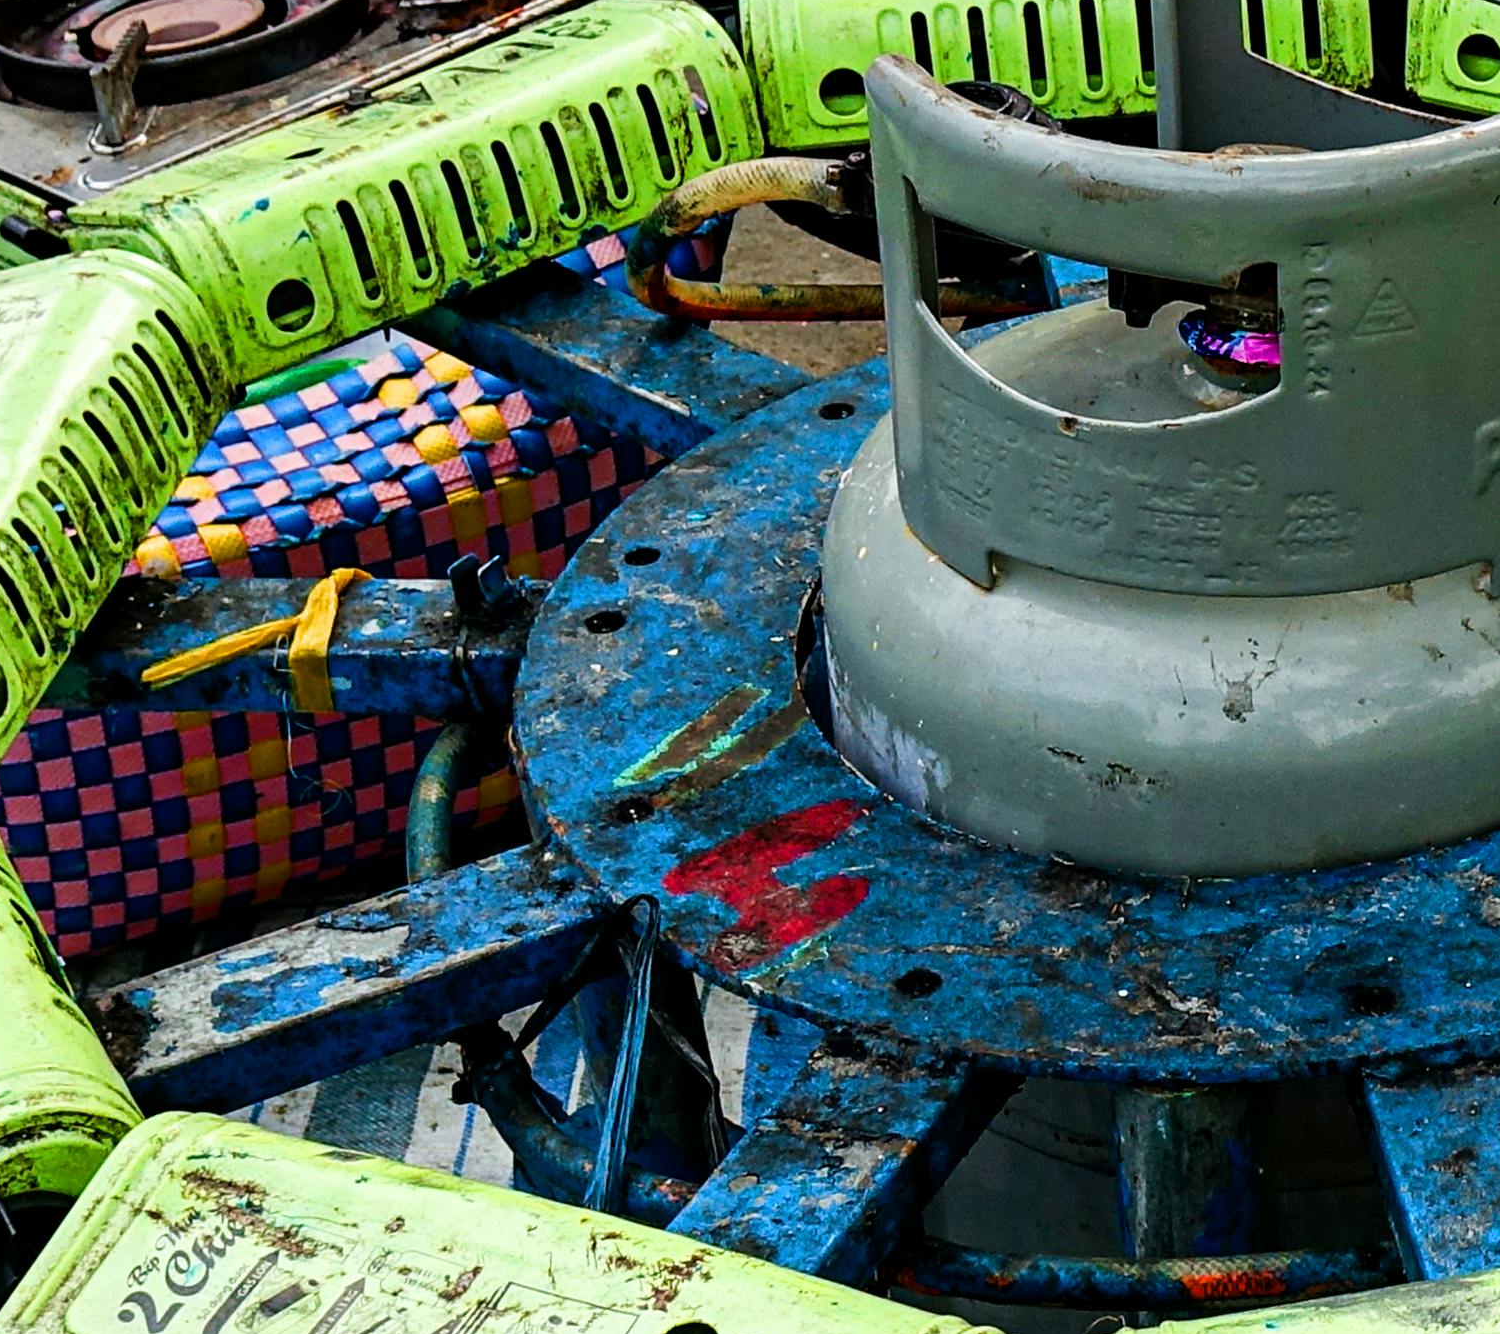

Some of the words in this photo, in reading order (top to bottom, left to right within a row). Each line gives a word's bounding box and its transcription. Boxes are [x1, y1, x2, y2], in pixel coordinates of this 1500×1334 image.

[116, 1290, 186, 1334] 2
[164, 1209, 250, 1297] Chi
[127, 1255, 161, 1289] Bếp
[237, 1277, 258, 1299] GAS
[254, 1260, 273, 1280] LON
